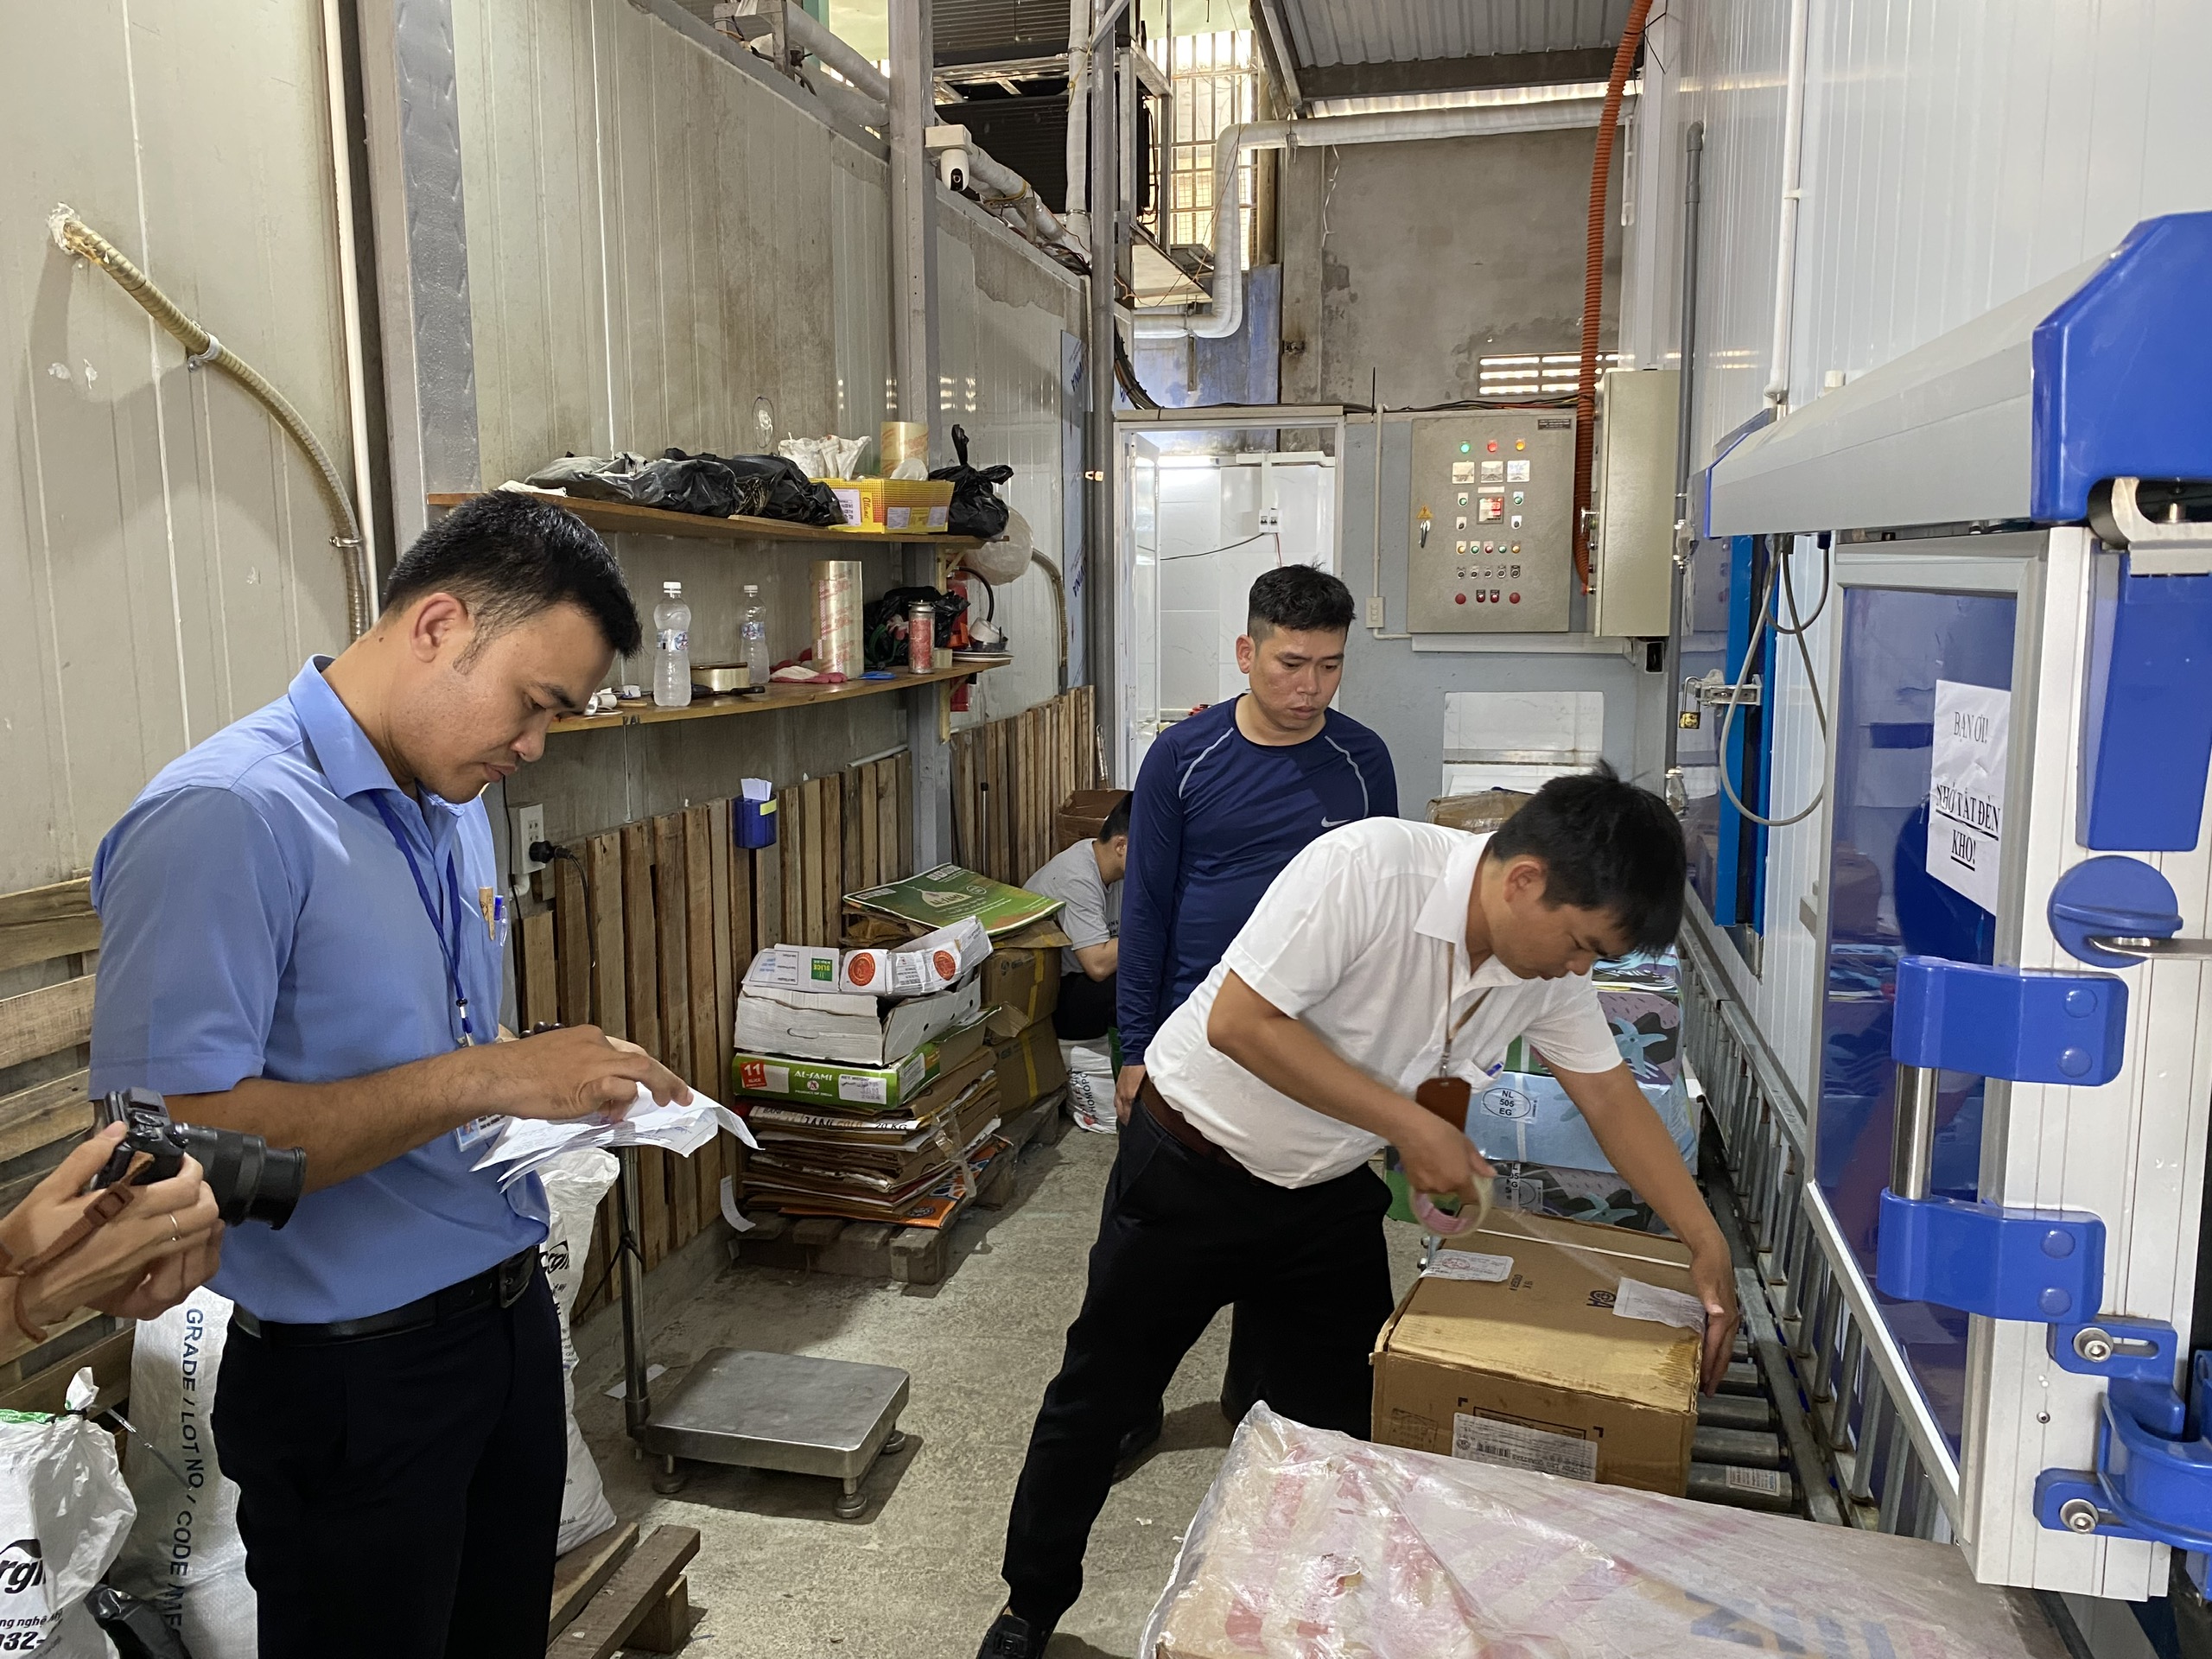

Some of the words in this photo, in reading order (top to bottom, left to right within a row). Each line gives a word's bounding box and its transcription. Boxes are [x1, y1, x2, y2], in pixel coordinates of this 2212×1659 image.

[862, 497, 871, 518] Allana
[1954, 711, 1974, 743] BẠN
[1974, 714, 1988, 744] ƠI!
[1936, 781, 1955, 813] NHỚ
[1977, 795, 2000, 833] ĐÈN
[1951, 830, 1976, 865] KHO!
[744, 1063, 760, 1076] 11
[181, 1308, 204, 1392] GRADE
[181, 1411, 200, 1454] LOT
[168, 1510, 194, 1576] CODE
[16, 1616, 48, 1629] nghệ
[0, 1630, 45, 1651] 32-
